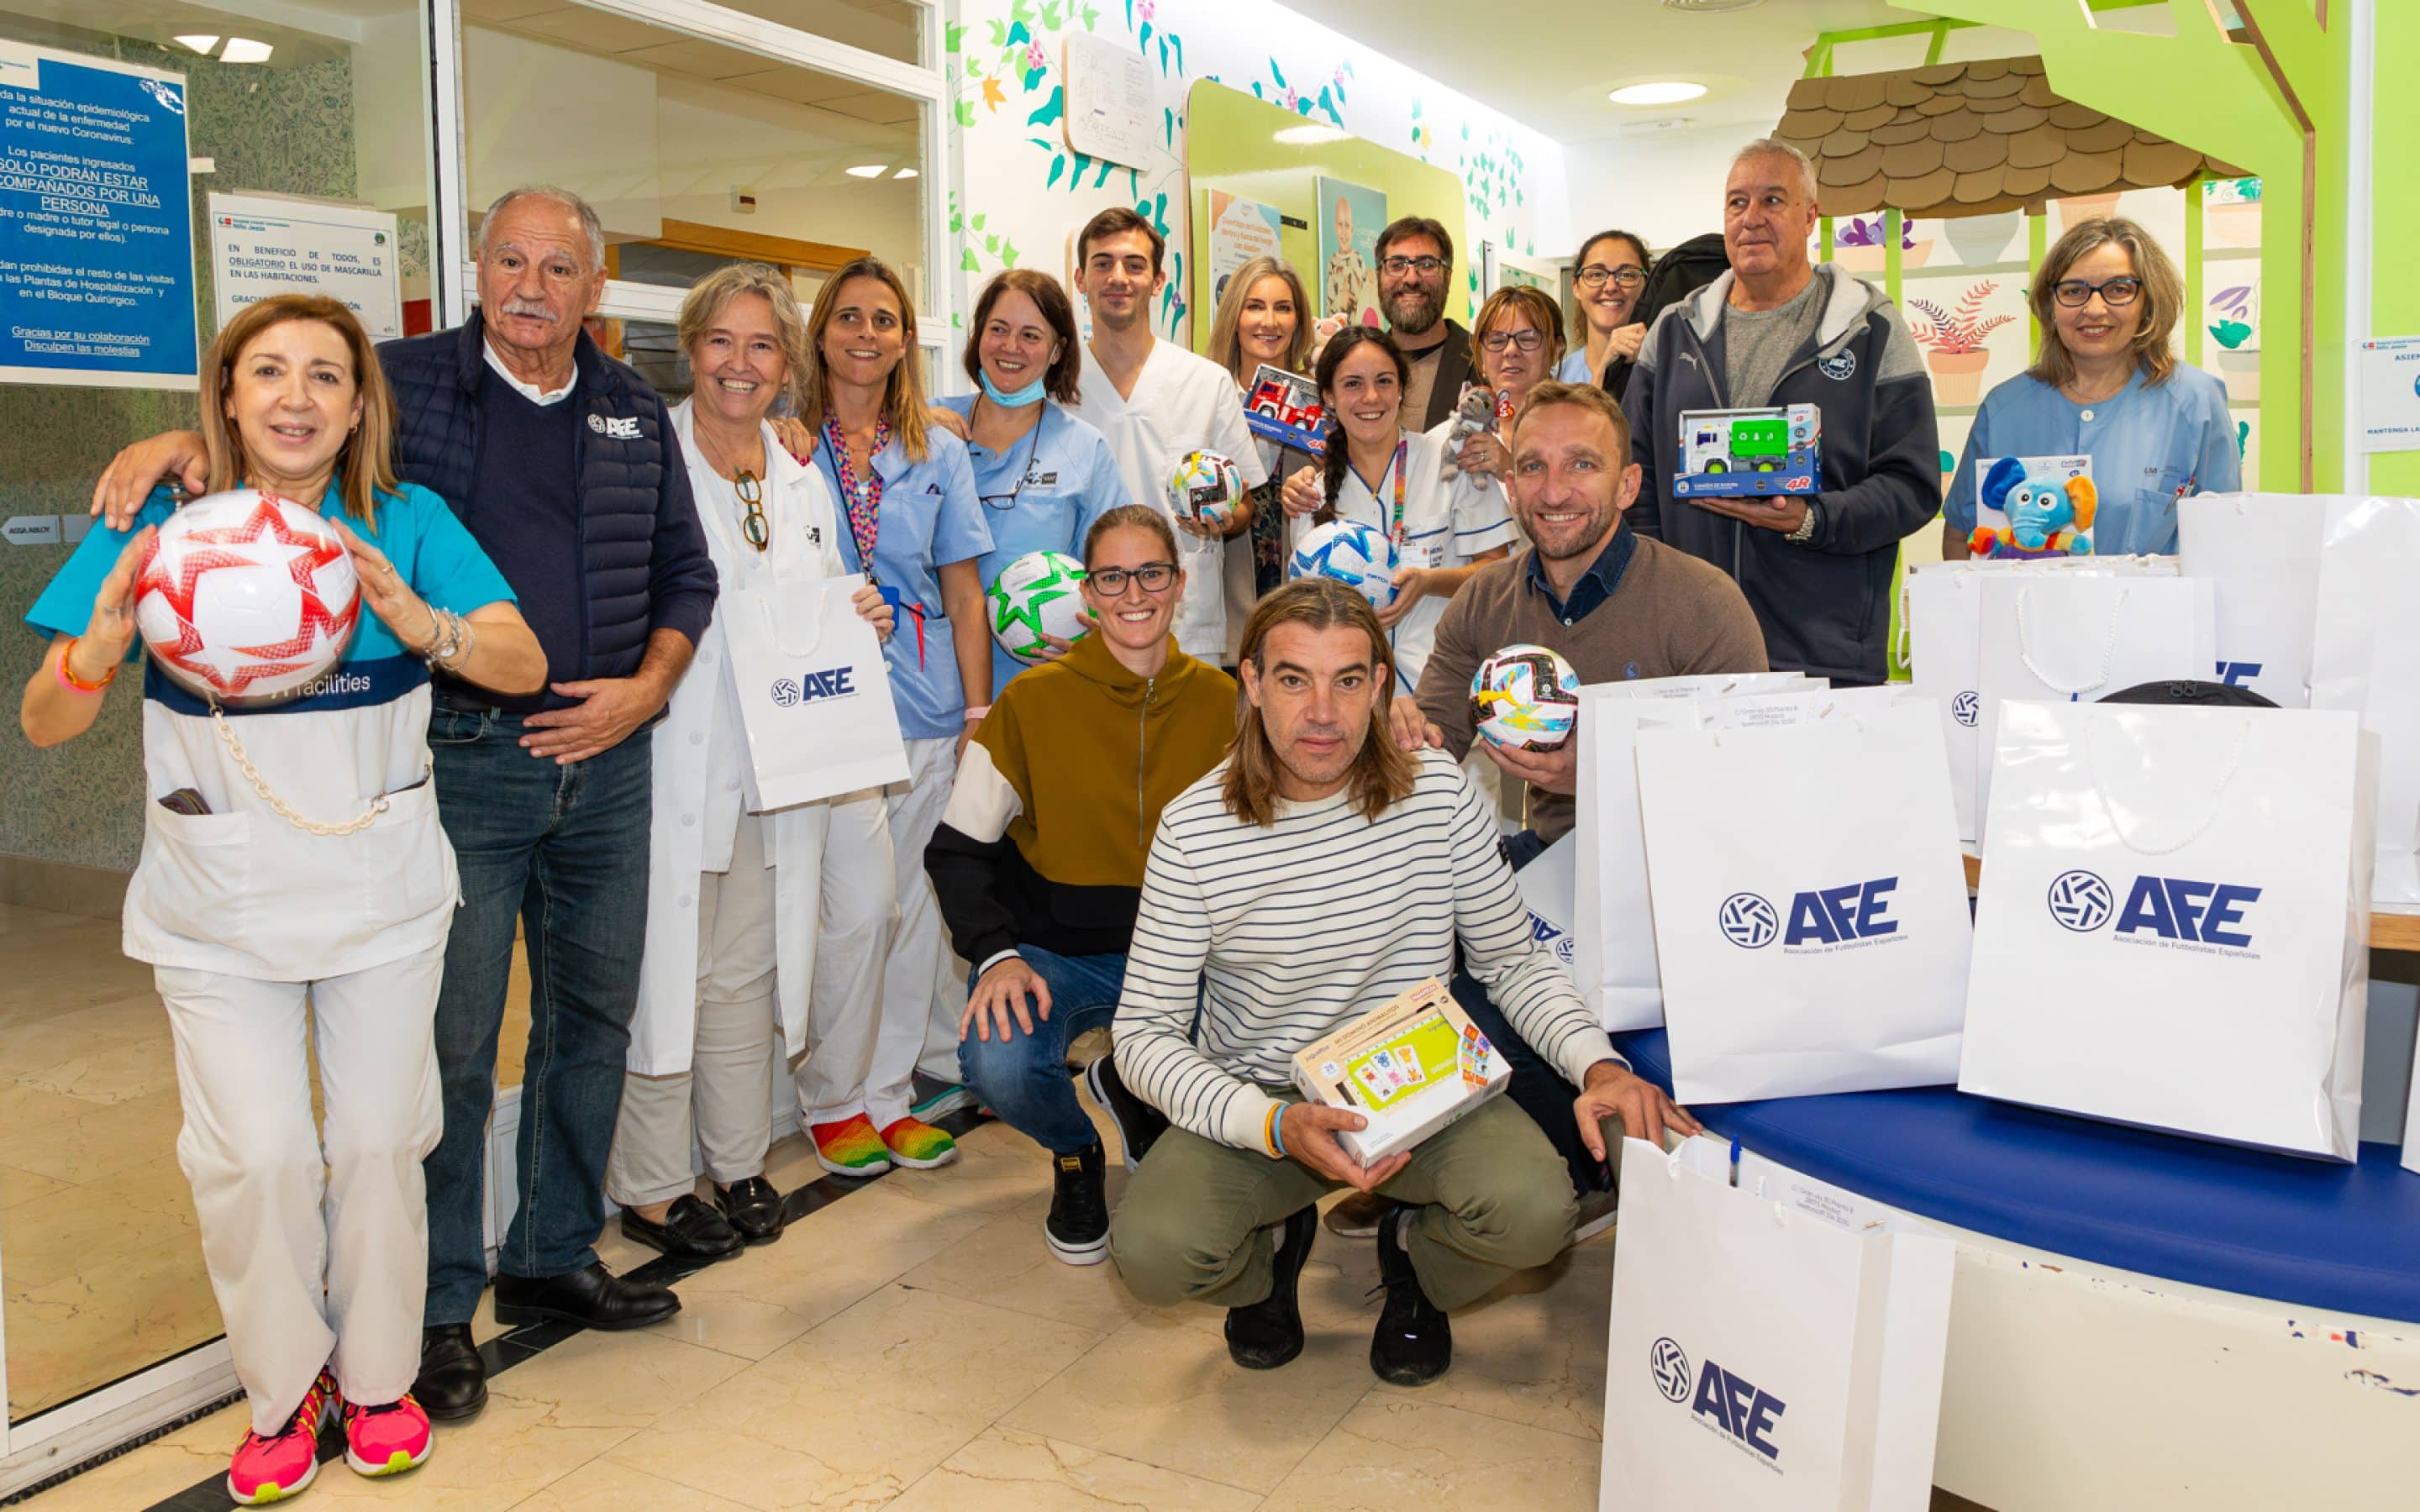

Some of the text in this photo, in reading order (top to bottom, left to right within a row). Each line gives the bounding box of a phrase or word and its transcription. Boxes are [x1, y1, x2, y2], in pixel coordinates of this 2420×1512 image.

[16, 92, 26, 102] la
[29, 94, 75, 110] situación
[76, 103, 150, 123] epidemiológica
[5, 118, 24, 129] por
[25, 119, 35, 129] el
[38, 123, 70, 135] nuevo
[8, 105, 130, 132] actual de la enfermedad
[8, 144, 135, 173] Los pacientes ingresados
[39, 162, 100, 182] PODRÁN
[103, 171, 149, 188] ESTAR
[41, 195, 110, 213] PERSONA
[99, 186, 129, 202] POR
[132, 192, 160, 206] UNA
[17, 210, 24, 219] o
[26, 212, 60, 223] madre
[71, 216, 94, 228] tutor
[96, 218, 120, 232] legal
[131, 224, 170, 237] persona
[24, 223, 77, 239] designada
[79, 230, 95, 240] por
[228, 244, 381, 266] EN BENEFICIO DE TODOS, ES
[20, 262, 73, 276] prohibidas
[76, 266, 85, 276] el
[87, 267, 113, 279] resto
[114, 270, 127, 280] de
[129, 270, 144, 282] las
[145, 273, 176, 286] visitas
[229, 256, 382, 276] OBLIGATORIO EL USO DE MASCARILLA
[229, 269, 320, 284] EN LAS HABITACIONES.
[5, 273, 22, 284] las
[24, 274, 63, 288] Plantas
[65, 277, 78, 289] de
[80, 280, 154, 296] Hospitalización
[157, 287, 165, 297] y
[18, 289, 33, 297] en
[35, 288, 45, 299] el
[47, 289, 83, 303] Bloque
[12, 325, 150, 344] Gracias por su colaboración
[24, 339, 141, 356] Disculpen las molestias
[605, 417, 640, 436] AFE
[802, 666, 855, 701] AFE
[1783, 876, 1899, 945] AFE
[2115, 875, 2263, 948] AFE
[1783, 946, 1823, 955] Asociación
[1824, 946, 1833, 954] de
[2112, 934, 2157, 947] Asociación
[2159, 939, 2169, 948] de
[2171, 941, 2216, 955] Futbolistas
[1692, 1359, 1786, 1461] AFE
